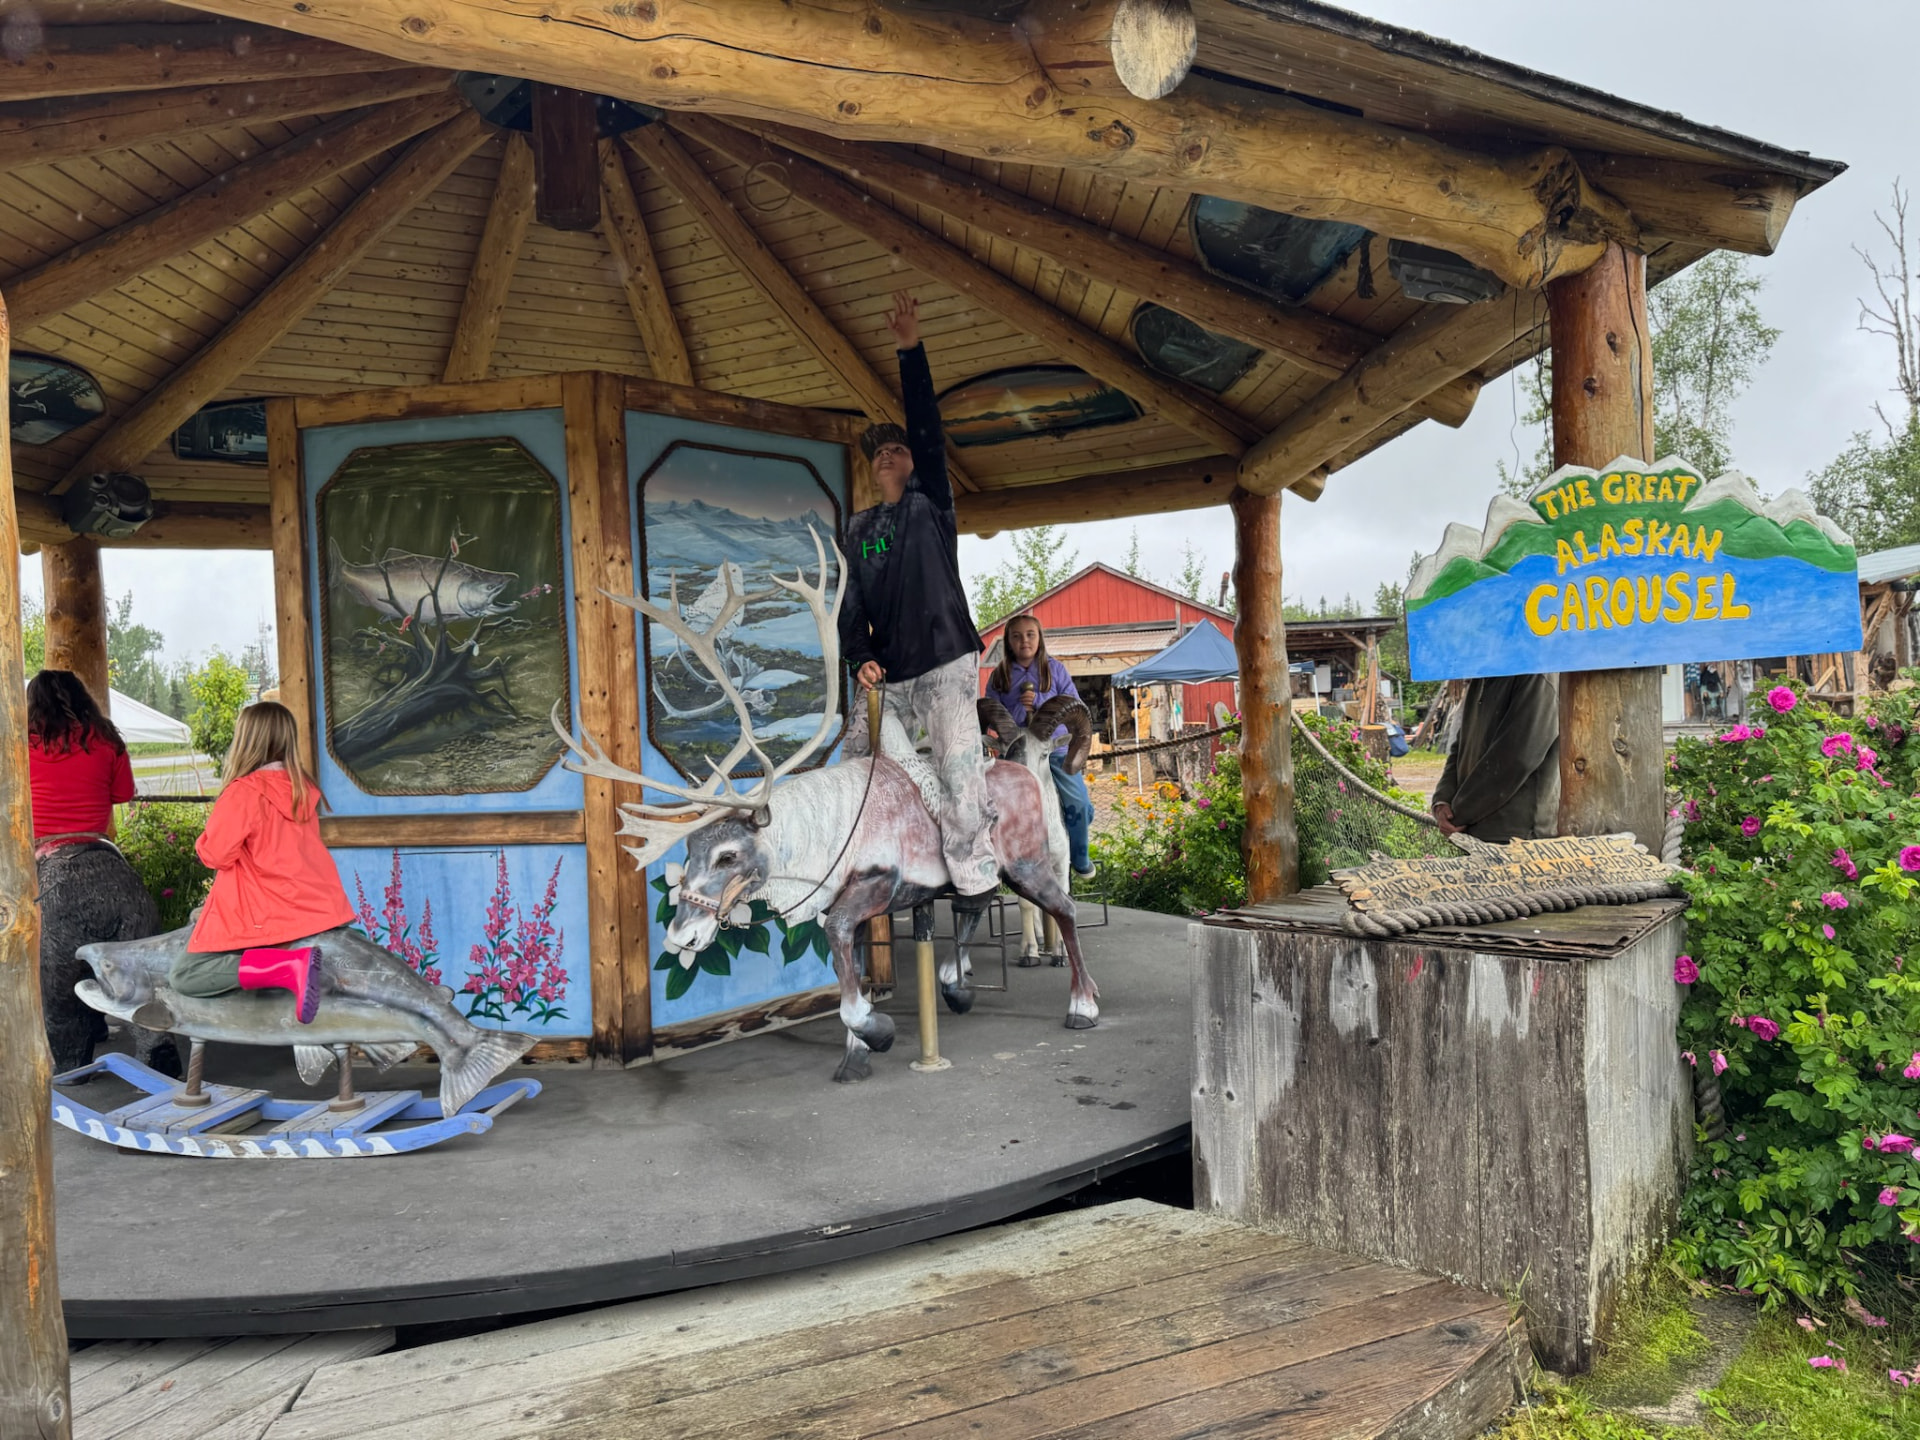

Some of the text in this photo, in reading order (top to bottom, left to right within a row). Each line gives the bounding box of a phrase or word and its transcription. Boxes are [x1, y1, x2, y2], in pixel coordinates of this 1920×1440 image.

[1536, 473, 1698, 519] THE GREAT
[1556, 518, 1723, 575] ALASKAN
[1524, 572, 1751, 636] CAROUSEL
[1356, 837, 1623, 884] THESE CARVINGS ARE FANTASTIC
[1369, 876, 1430, 900] PHOTOS
[1432, 874, 1458, 885] TO
[1519, 863, 1551, 878] ALL
[1549, 858, 1589, 875] YOUR
[1590, 854, 1653, 873] FRIENDS
[1431, 883, 1516, 902] DONATION
